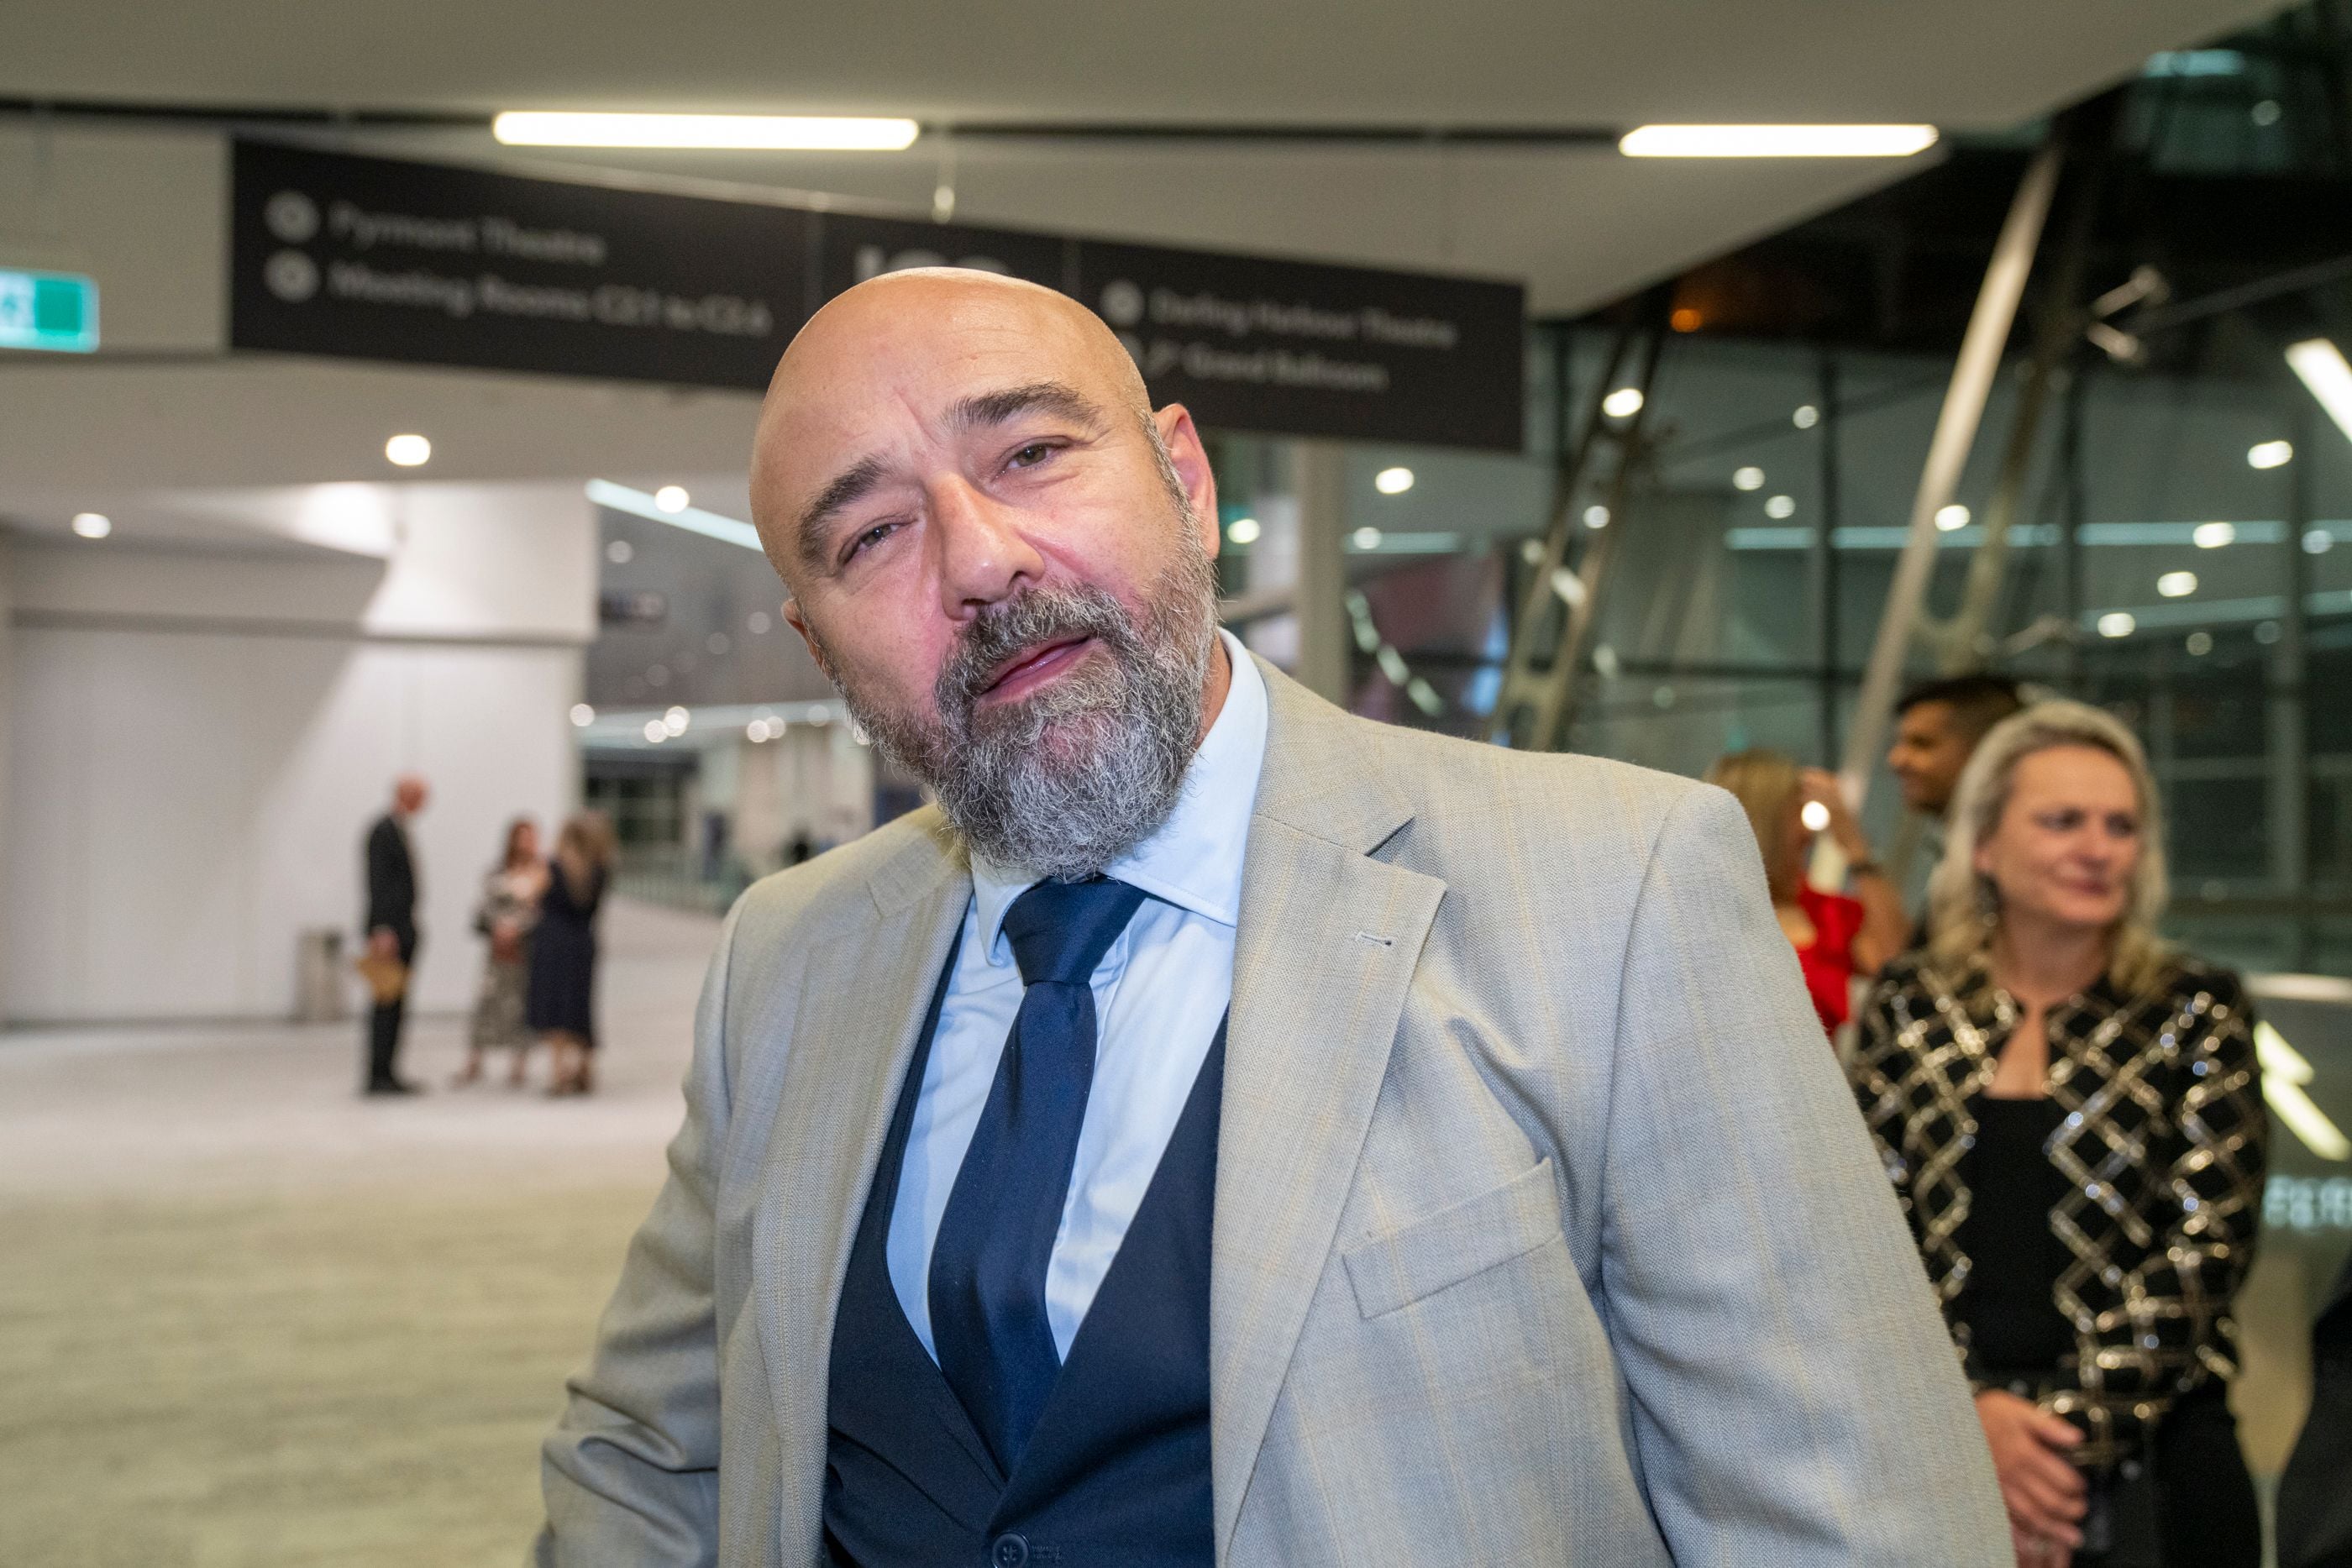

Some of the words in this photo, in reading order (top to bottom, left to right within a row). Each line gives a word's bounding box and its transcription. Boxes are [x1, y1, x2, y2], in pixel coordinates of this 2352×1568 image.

[483, 217, 605, 265] Theatre
[329, 262, 470, 317] Meeting
[476, 275, 588, 320] Rooms
[1151, 288, 1248, 334] Darling
[1252, 298, 1356, 339] Harbour
[1359, 307, 1456, 349] Theatre
[1182, 342, 1265, 381] Grand
[1269, 349, 1389, 391] Ballroom
